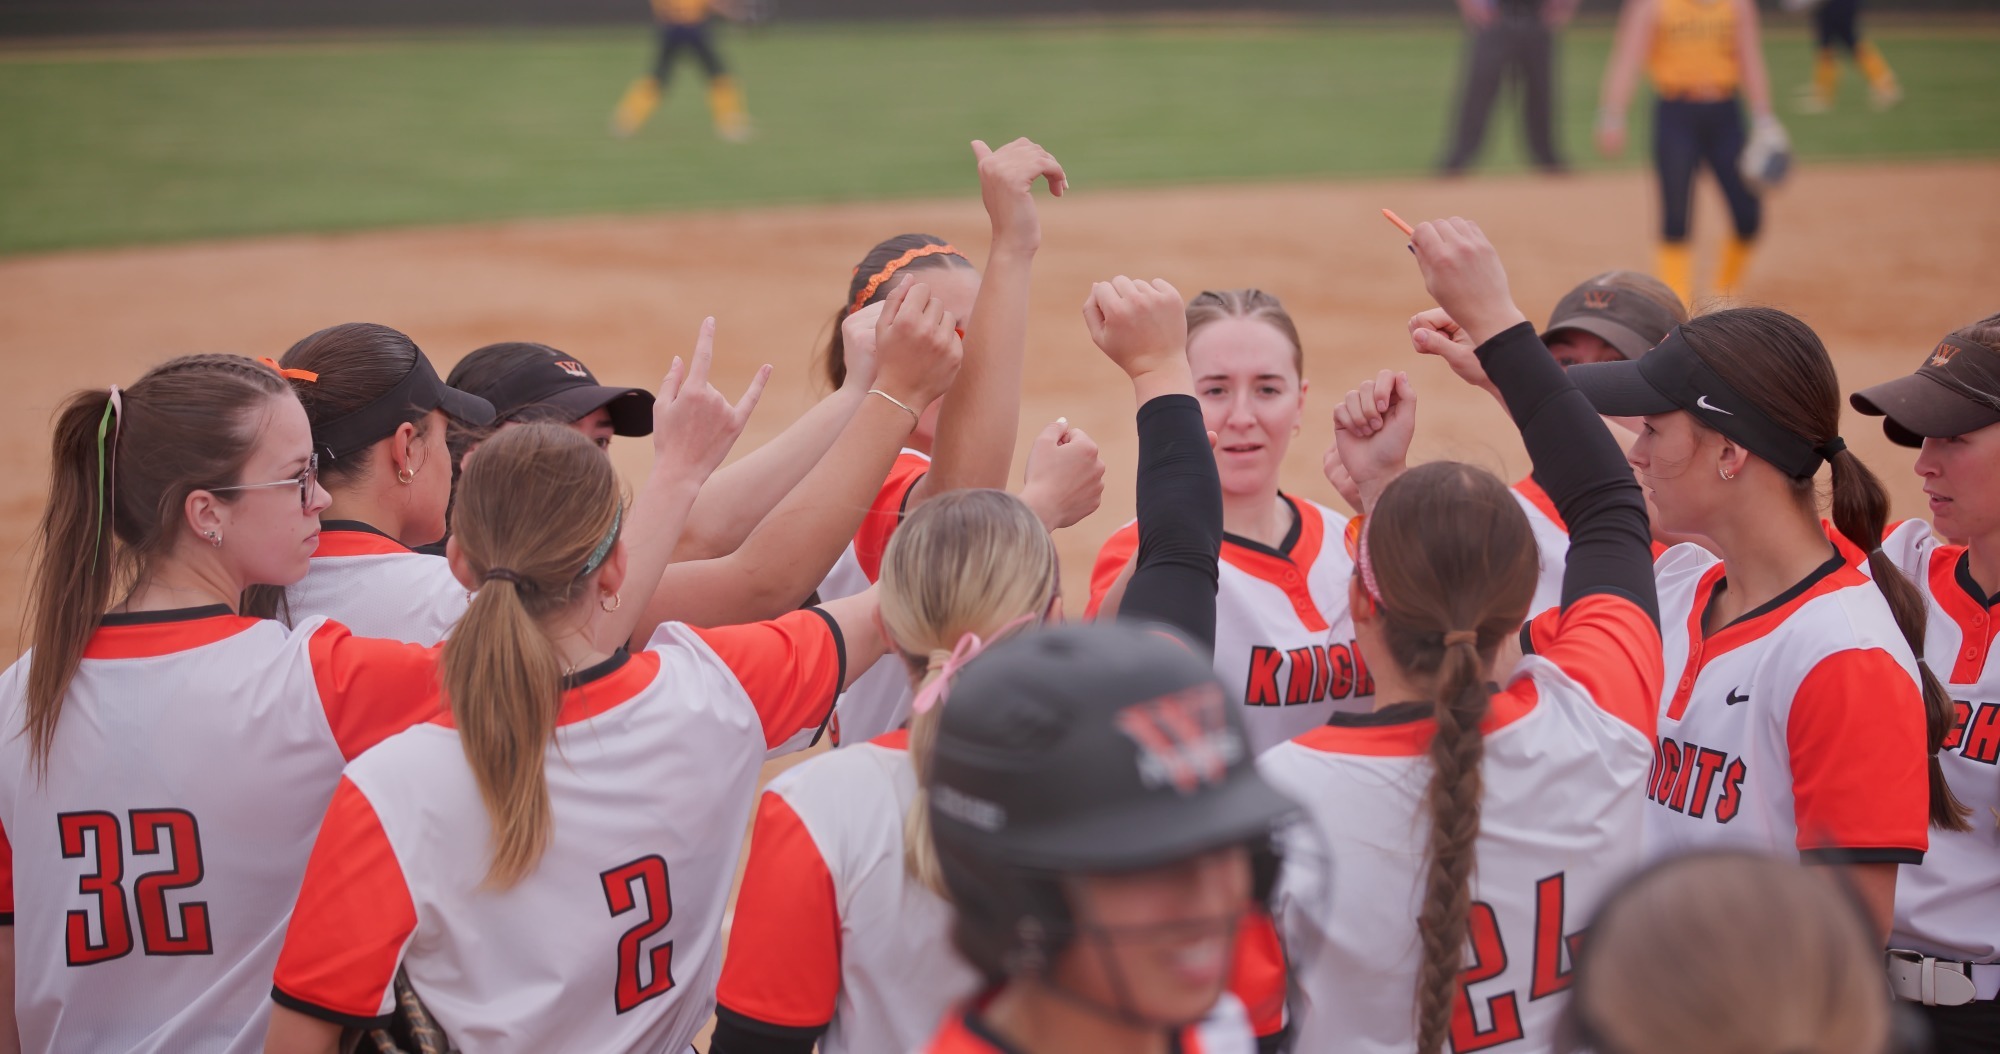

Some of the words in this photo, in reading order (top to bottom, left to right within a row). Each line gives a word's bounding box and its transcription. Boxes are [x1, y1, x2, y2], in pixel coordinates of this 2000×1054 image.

[1646, 735, 1747, 824] IGHTS
[57, 808, 213, 967] 32
[600, 853, 676, 1015] 2
